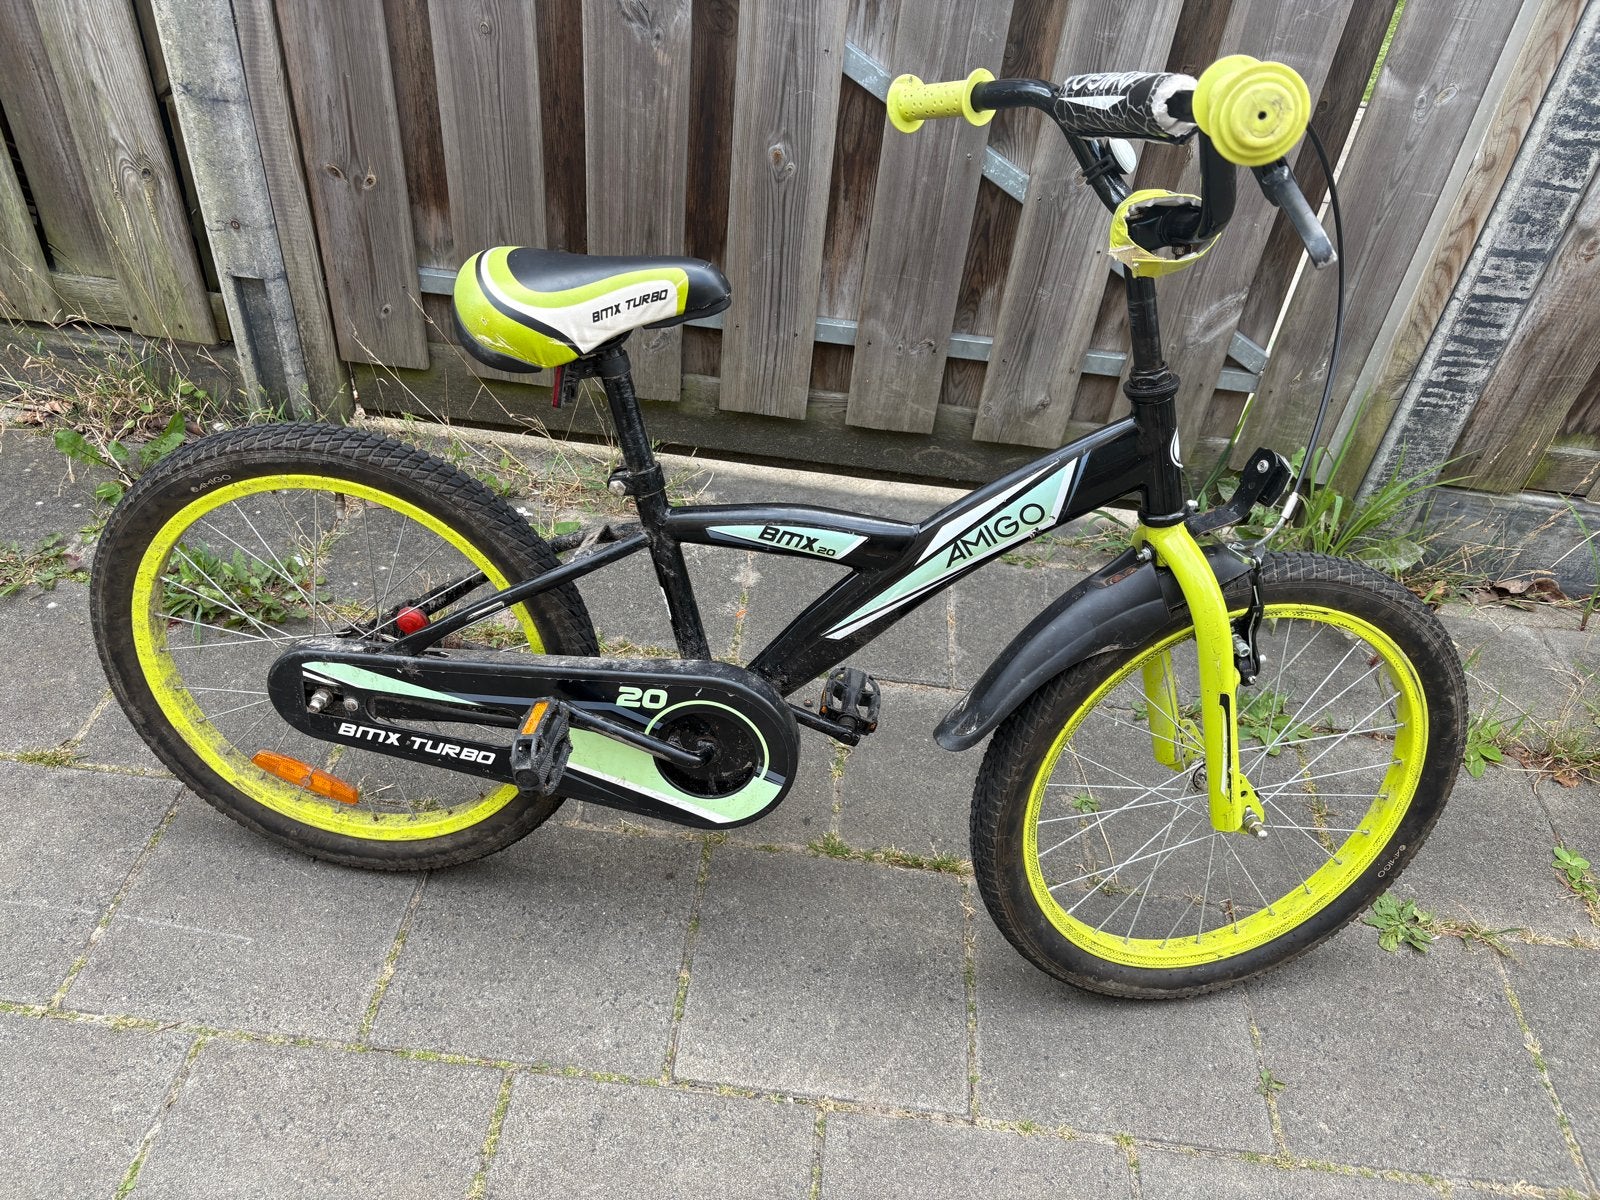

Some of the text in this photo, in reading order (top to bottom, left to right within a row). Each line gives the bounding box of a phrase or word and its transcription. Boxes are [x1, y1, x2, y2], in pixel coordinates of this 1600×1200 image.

[592, 289, 668, 323] BMX TURBO
[758, 525, 836, 557] BMX 20
[946, 503, 1045, 568] AMIGO
[616, 686, 668, 709] 20
[338, 722, 496, 765] BMX TURBO
